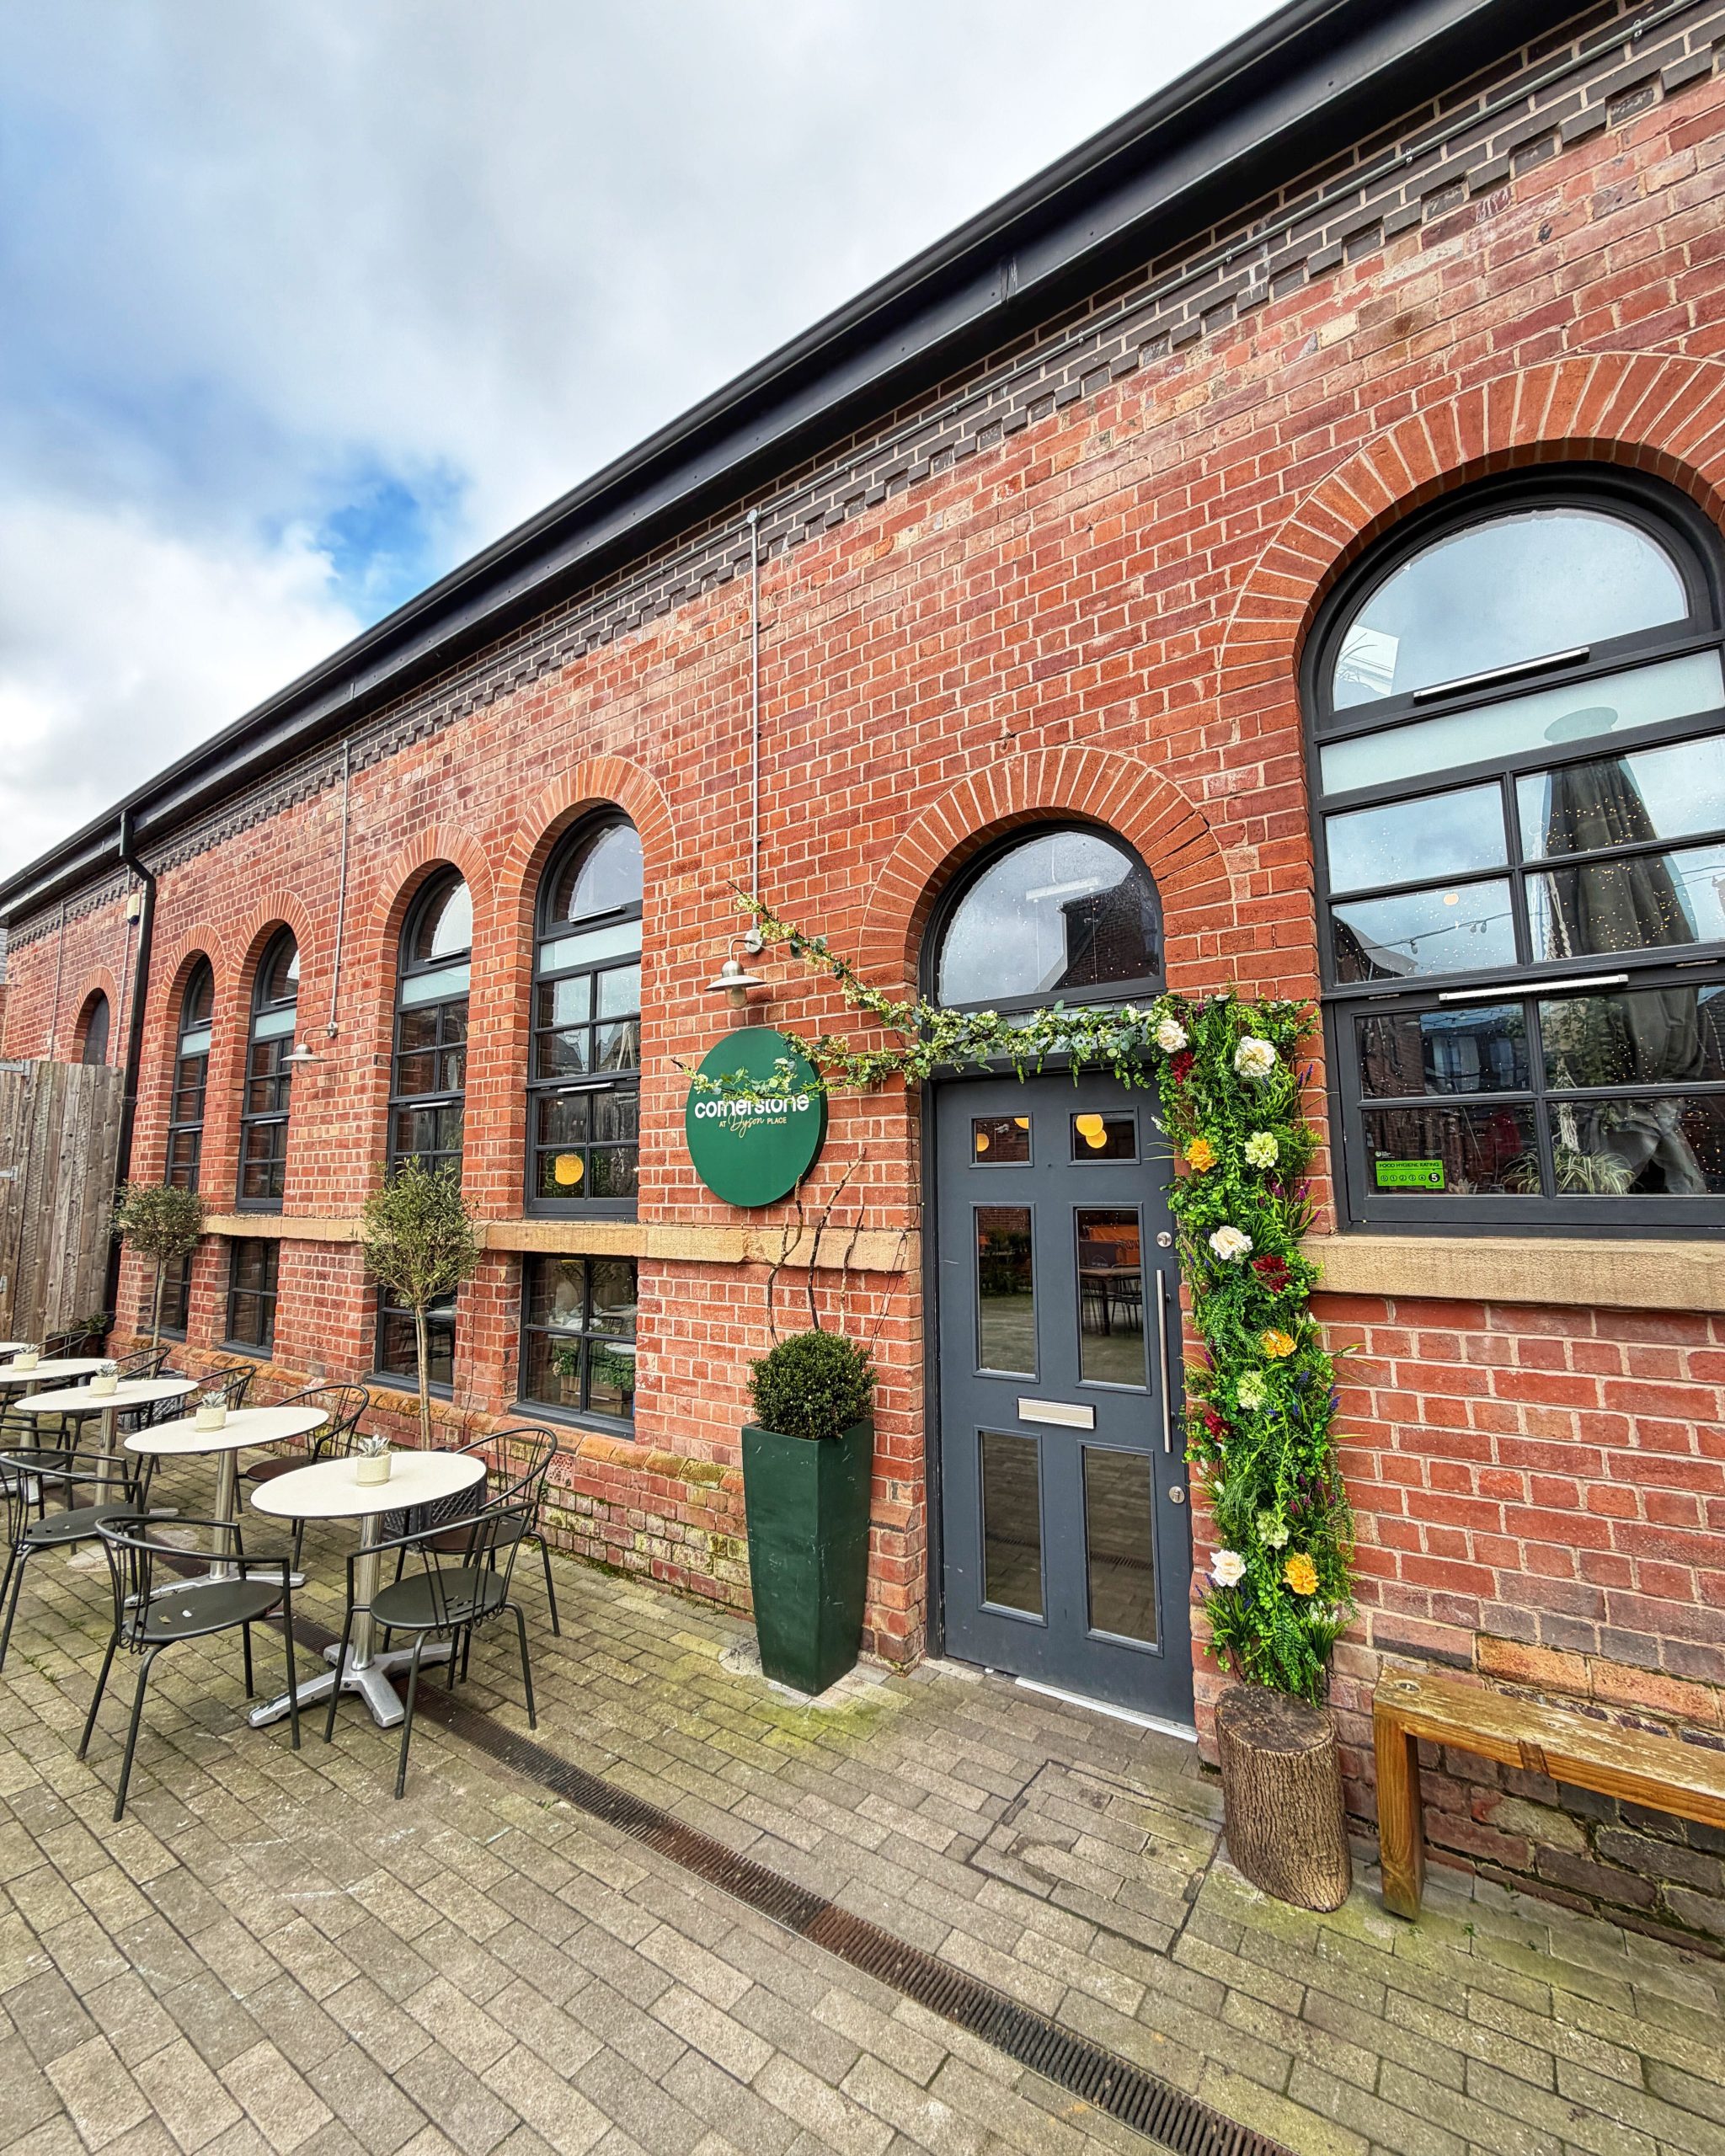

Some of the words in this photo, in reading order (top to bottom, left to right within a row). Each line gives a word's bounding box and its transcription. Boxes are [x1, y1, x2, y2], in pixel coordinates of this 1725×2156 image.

[695, 1094, 809, 1118] cornerstone
[728, 1113, 765, 1138] Dyson
[1431, 1173, 1438, 1182] 5
